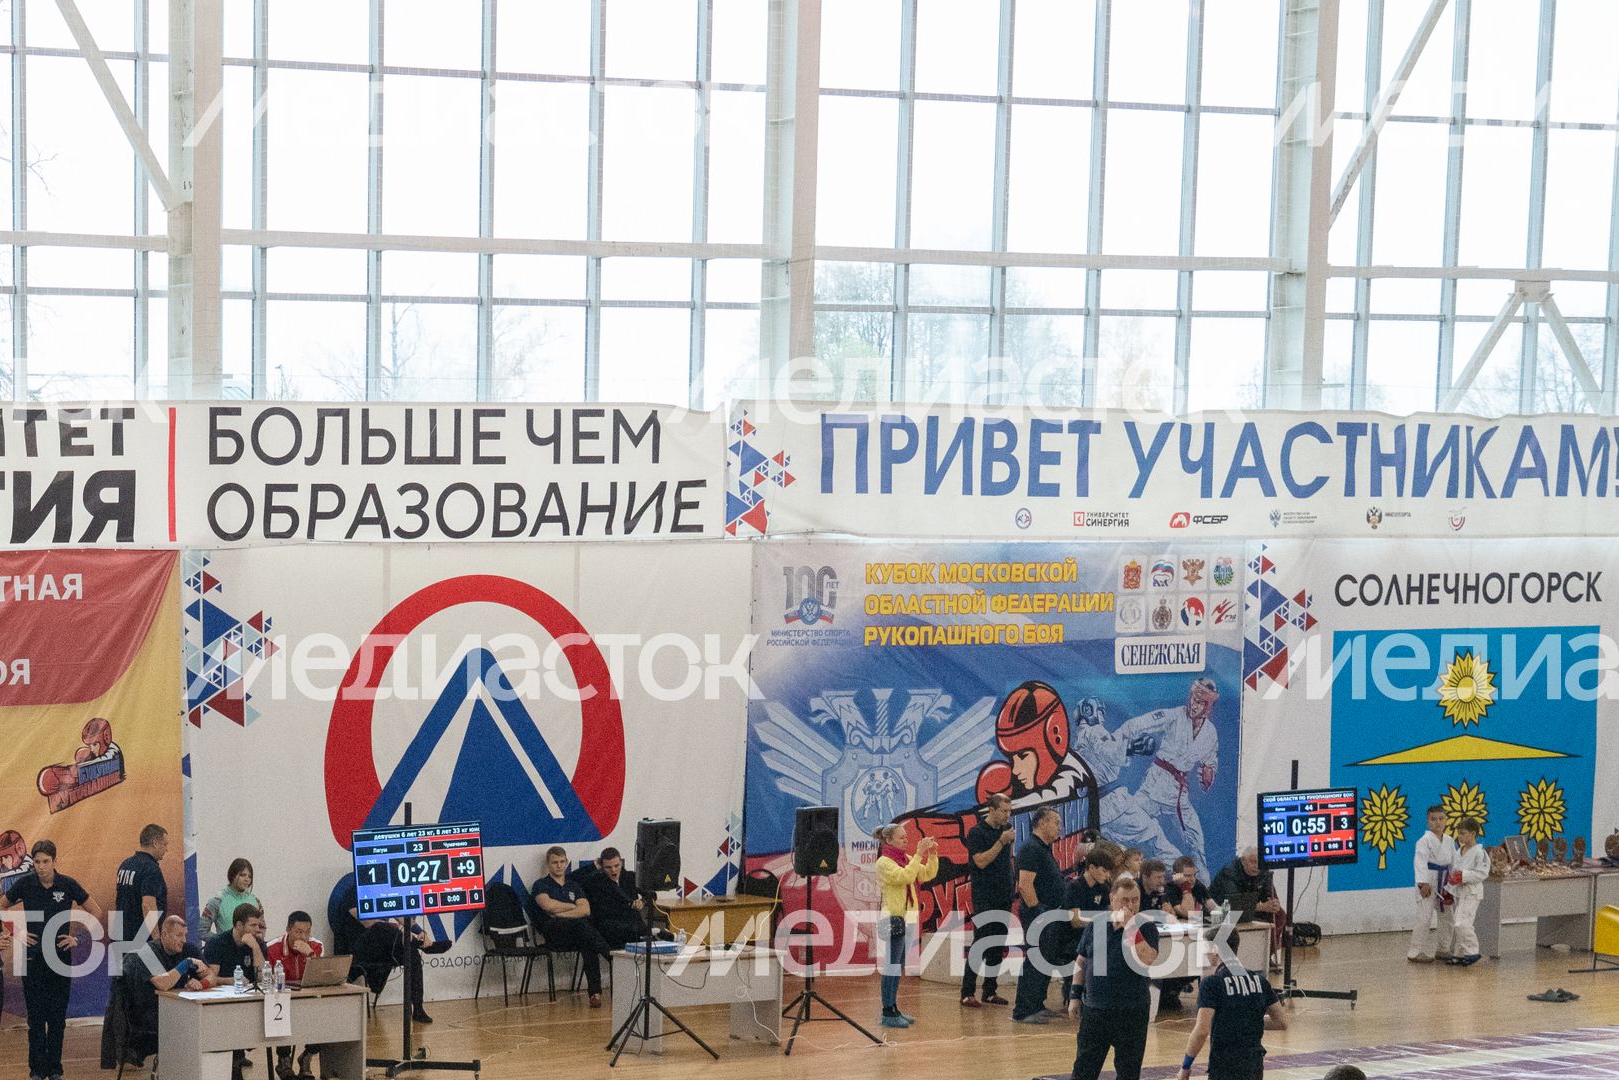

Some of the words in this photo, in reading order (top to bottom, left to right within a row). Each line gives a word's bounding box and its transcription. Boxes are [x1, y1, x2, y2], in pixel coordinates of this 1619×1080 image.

[209, 406, 507, 466] БОЛЬШЕ
[526, 408, 662, 465] ЧЕМ
[820, 414, 1102, 498] ПРИВЕТ
[207, 479, 707, 540] ОБРАЗОВАНИЕ
[1192, 514, 1229, 525] ФСБР
[1086, 518, 1130, 527] СИНЕРГИЯ
[864, 562, 937, 585] КУБОК
[938, 557, 1079, 585] МОСКОВСКОЙ
[1334, 570, 1603, 608] СОЛНЕЧНОГОРСК
[863, 592, 988, 617] ОБЛАСТНОЙ
[990, 593, 1116, 615] ФЕДЕРАЦИИ
[864, 622, 1021, 647] РУКОПАШНОГО
[1023, 622, 1065, 645] БОЯ
[1120, 642, 1201, 668] СЕНЕЖСКАЯ
[1263, 822, 1284, 833] +10
[1292, 817, 1326, 834] 0:55
[1341, 817, 1348, 829] 3
[369, 868, 376, 883] 1
[398, 860, 441, 883] 0:27
[457, 860, 475, 875] +9
[1224, 975, 1263, 996] СУДЬЯ
[273, 1003, 284, 1021] 2
